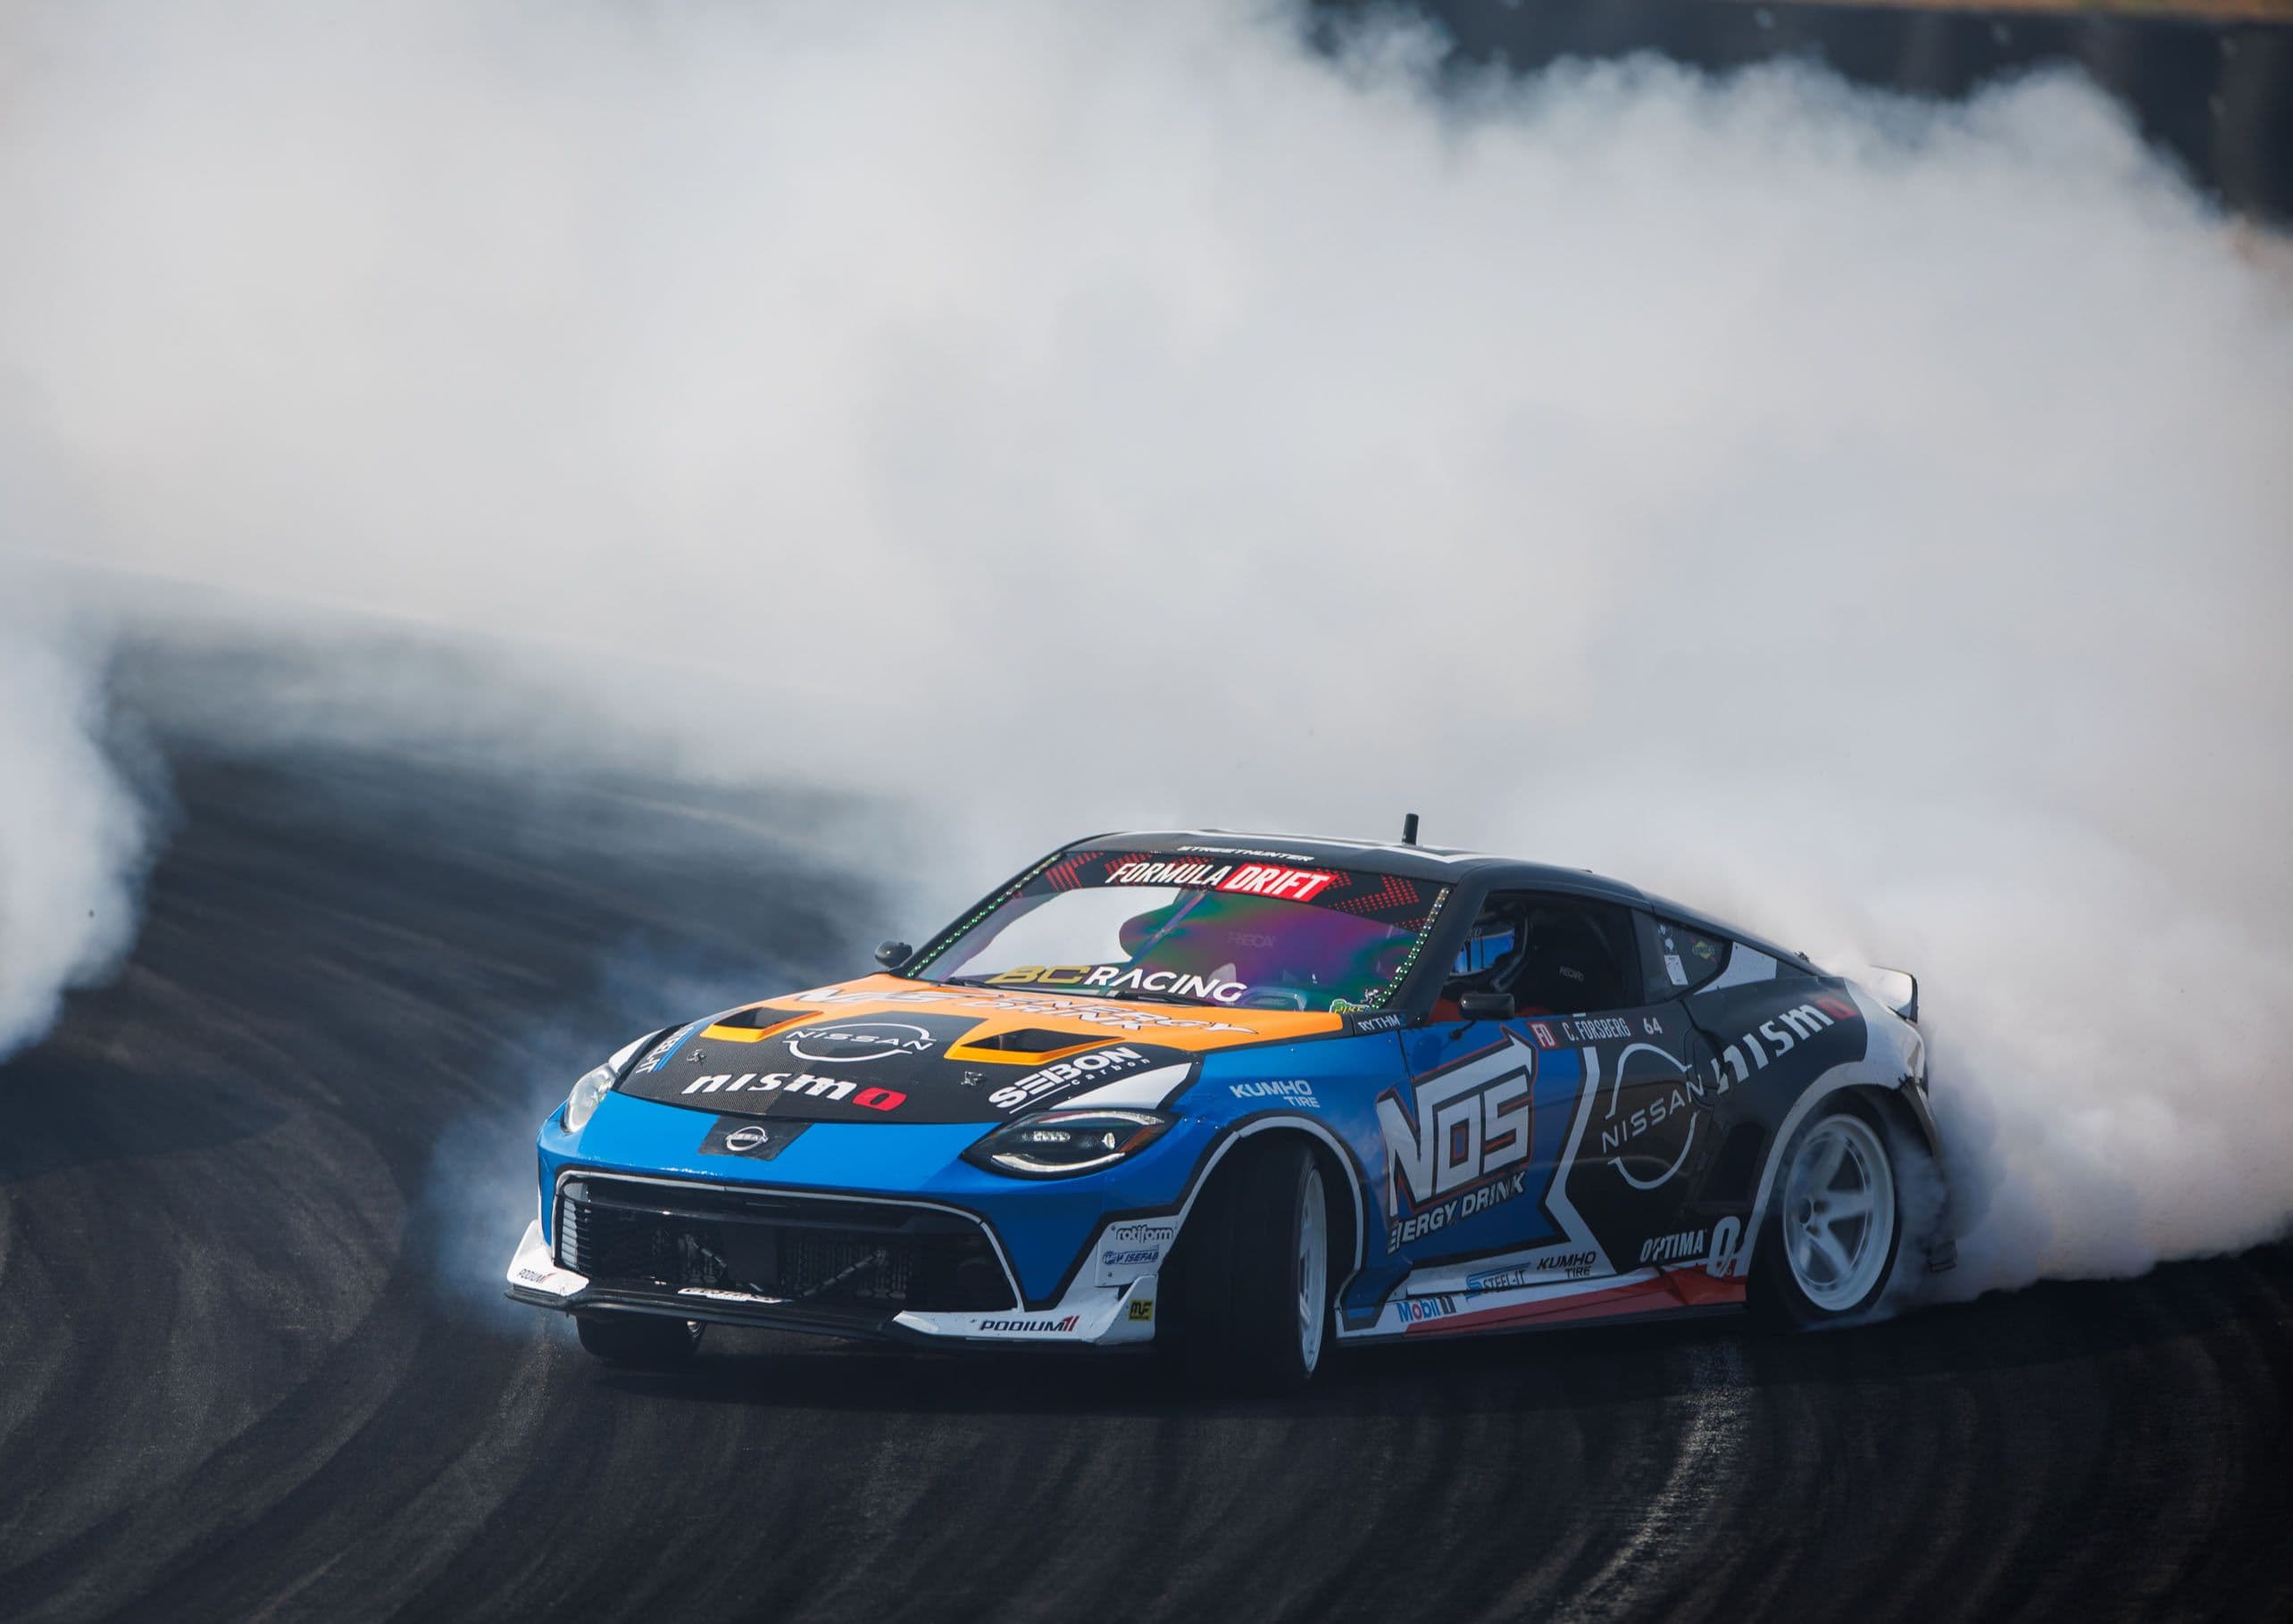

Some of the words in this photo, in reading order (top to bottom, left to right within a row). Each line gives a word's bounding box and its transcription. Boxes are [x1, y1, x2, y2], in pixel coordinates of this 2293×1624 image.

[1105, 862, 1232, 886] FORMULA
[1223, 866, 1330, 899] DRIFT
[1358, 1013, 1401, 1032] RYTHM
[1562, 1021, 1579, 1042] C.
[1574, 1018, 1631, 1041] FORSBERG
[1643, 1017, 1663, 1035] 64
[786, 1030, 933, 1051] NISSAN
[988, 1046, 1143, 1109] SEIBON
[1071, 1058, 1151, 1087] carbon
[1229, 1079, 1313, 1099] KUMHO
[1283, 1095, 1321, 1109] TIRE
[1601, 1074, 1705, 1153] NISSAN
[1376, 1034, 1532, 1218] NOS
[1461, 1170, 1526, 1218] DRINK
[1116, 1224, 1174, 1243] rotiform
[1639, 1229, 1704, 1263] OPTIMA
[1537, 1252, 1597, 1271] KUMHO
[1565, 1265, 1592, 1279] TIRE
[1397, 1298, 1440, 1322] Mobil
